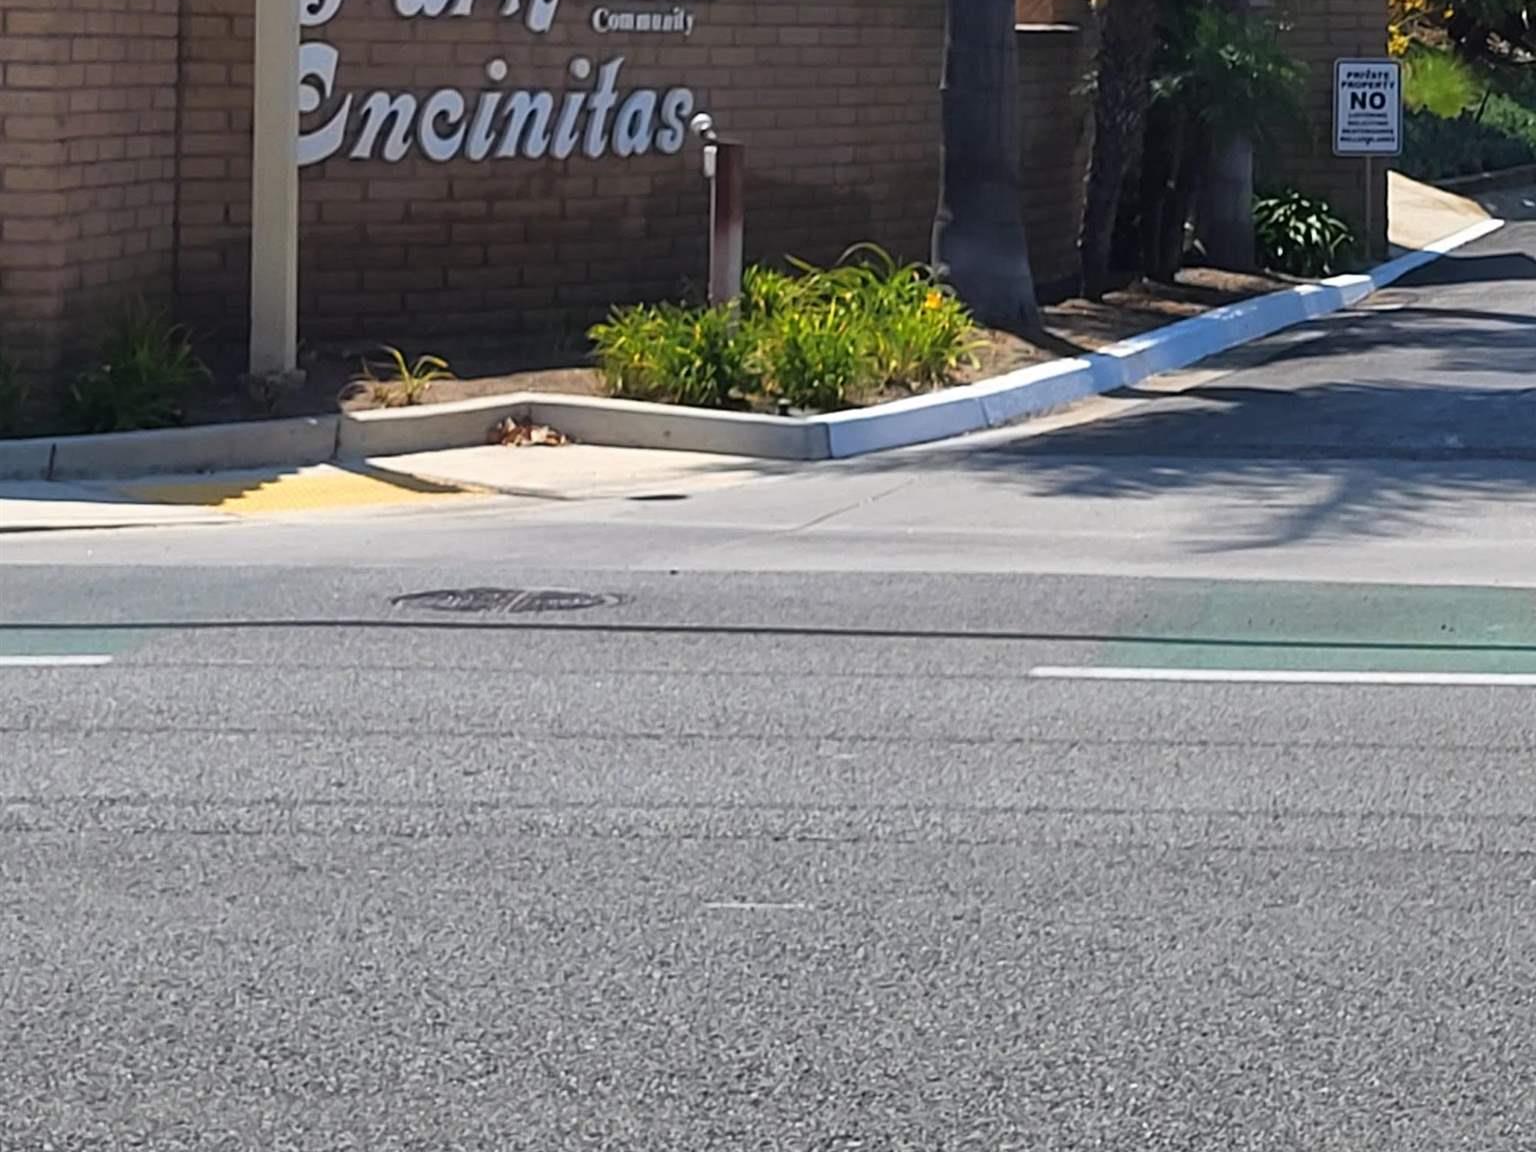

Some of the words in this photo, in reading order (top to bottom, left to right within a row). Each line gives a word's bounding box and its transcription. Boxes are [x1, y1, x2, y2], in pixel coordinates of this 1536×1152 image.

[592, 6, 695, 36] Community
[1341, 81, 1396, 89] PROPERTY
[297, 42, 694, 167] Encinitas
[1350, 92, 1386, 110] NO
